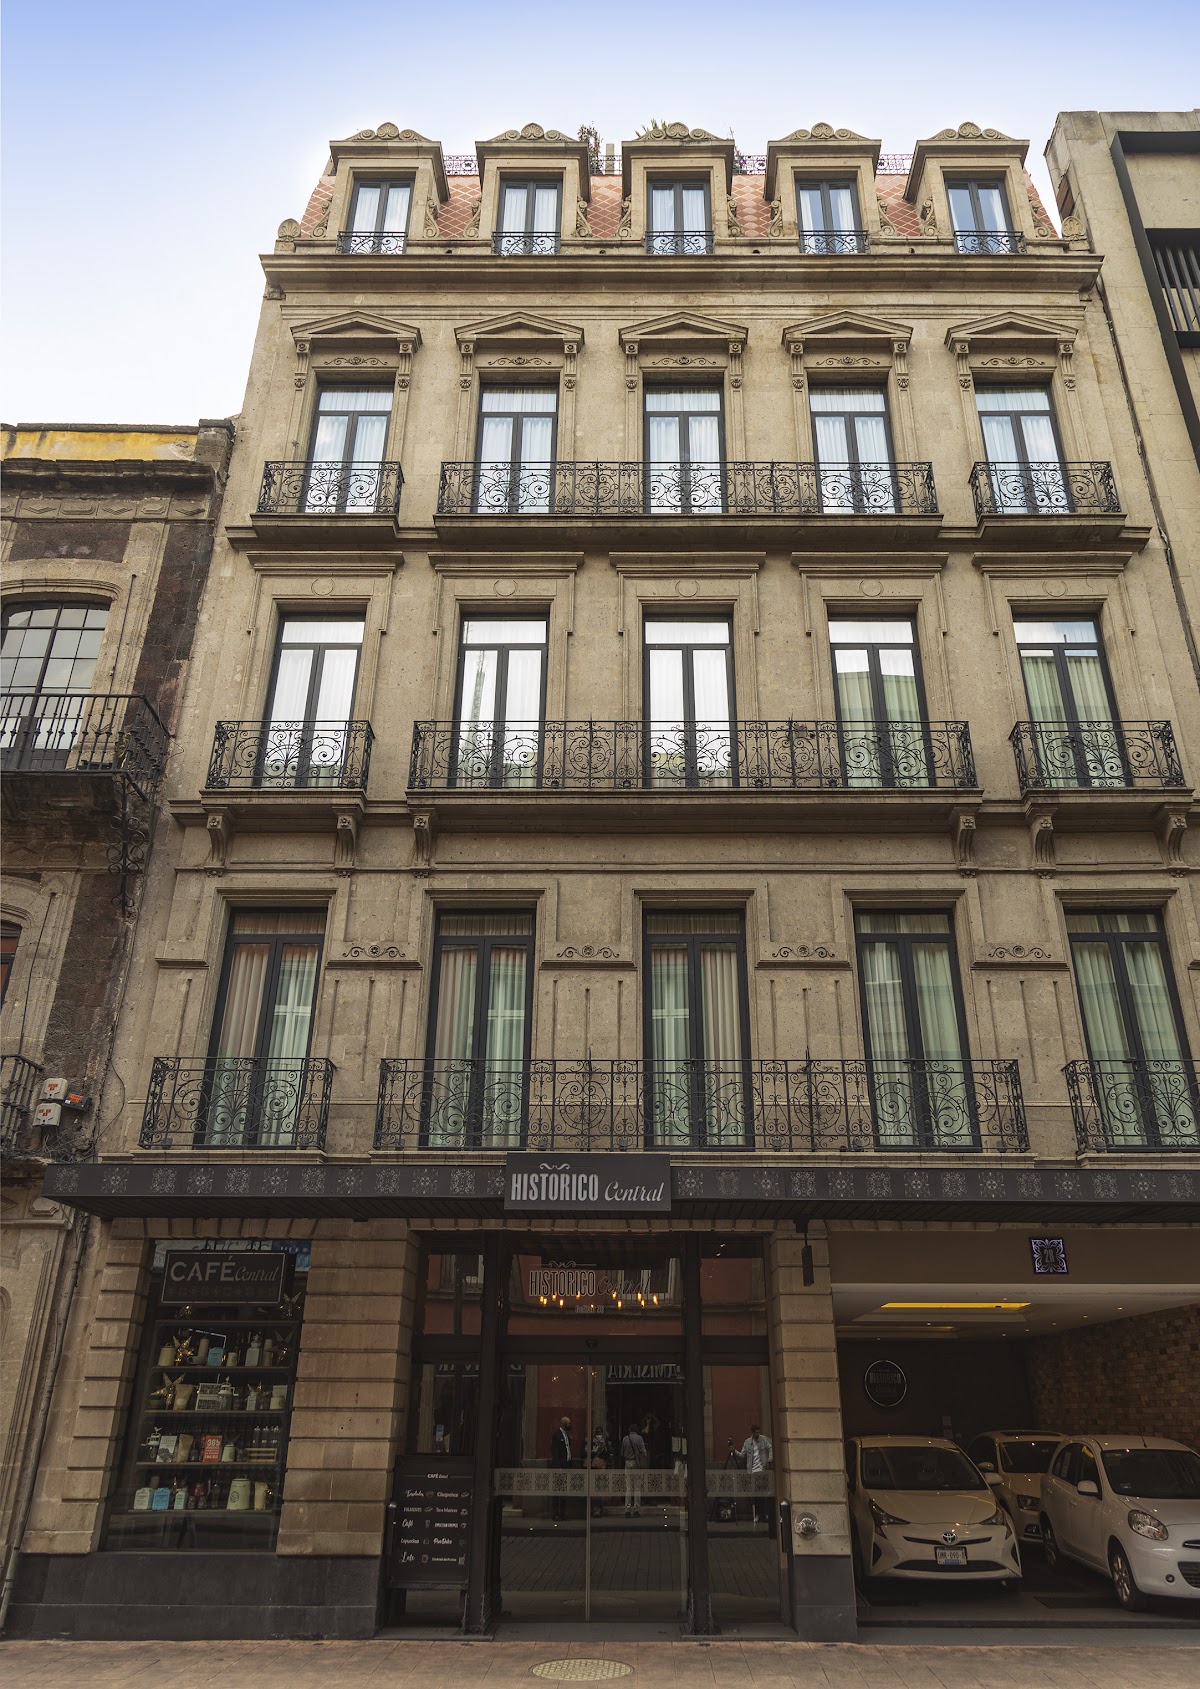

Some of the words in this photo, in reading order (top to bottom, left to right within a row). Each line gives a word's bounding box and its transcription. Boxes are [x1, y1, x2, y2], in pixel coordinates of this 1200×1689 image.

[511, 1173, 599, 1202] HISTORICO
[605, 1181, 665, 1202] Central
[170, 1255, 235, 1282] CAFÉ
[235, 1266, 279, 1283] Central
[1043, 1248, 1055, 1263] 28
[529, 1270, 596, 1297] HISTORICO
[597, 1271, 652, 1296] Central
